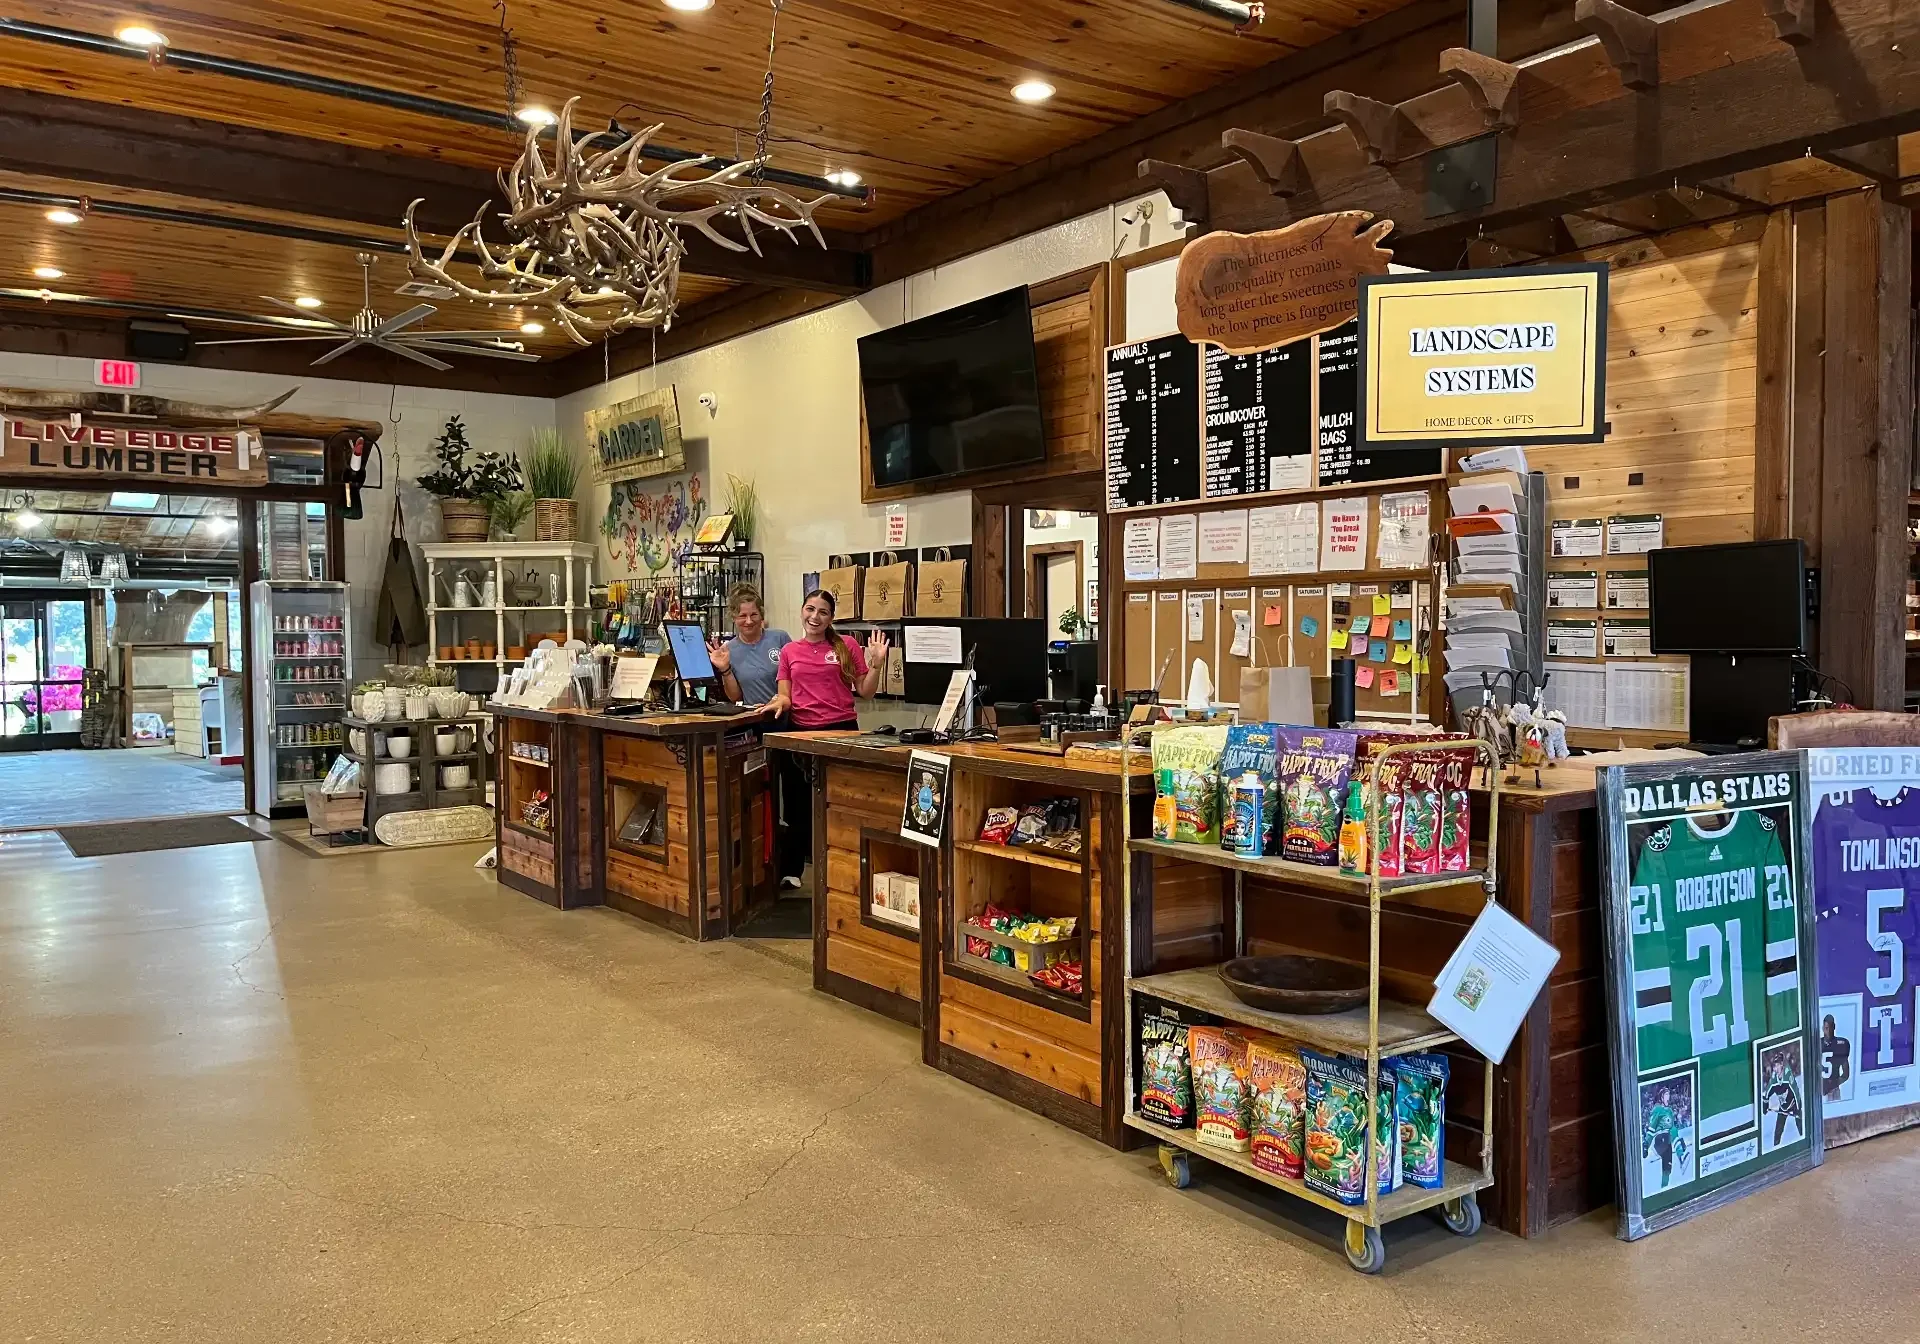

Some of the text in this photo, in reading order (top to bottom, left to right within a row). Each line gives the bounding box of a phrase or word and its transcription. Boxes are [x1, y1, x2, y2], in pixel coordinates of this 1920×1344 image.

[1220, 237, 1325, 273] The bitterness of
[1290, 257, 1342, 279] remains
[1199, 281, 1345, 320] long after the sweetness
[1207, 322, 1226, 337] the
[1229, 319, 1249, 333] low
[1252, 312, 1283, 333] price
[1286, 310, 1297, 322] is
[1411, 325, 1554, 353] LANDSCAPE
[1112, 343, 1148, 362] ANNUALS
[100, 360, 136, 386] EXIT
[1428, 366, 1534, 393] SYSTEMS
[1205, 405, 1266, 427] GROUNDCOVER
[1319, 411, 1353, 430] MULCH
[1424, 414, 1534, 427] HOME DECOR GIFTS
[11, 421, 233, 454] LIVE EDGE
[597, 414, 664, 466] GARDEN
[1320, 430, 1347, 447] BAGS
[30, 442, 218, 477] LUMBER
[1332, 515, 1341, 523] We
[1341, 515, 1356, 523] Have
[1337, 535, 1347, 543] You
[1347, 534, 1359, 543] Buy
[1189, 592, 1214, 600] WEDNESDAY
[1298, 588, 1323, 596] SATURDAY
[1360, 586, 1377, 594] NOTES
[1156, 742, 1194, 765] HAPPY
[1223, 749, 1258, 773] HAPPY
[1280, 753, 1313, 777] HAPPY
[1624, 773, 1791, 813] DALLAS STARS
[1675, 866, 1756, 912] ROBERTSON
[1764, 864, 1794, 911] 21
[1631, 883, 1665, 935] 21
[1866, 888, 1906, 998] 5
[1685, 918, 1750, 1057] 21
[1141, 1018, 1175, 1040] HAPPY
[1869, 1003, 1903, 1066] T
[1252, 1054, 1286, 1079] HAPPY
[1303, 1055, 1341, 1077] MARINE
[1311, 1178, 1362, 1199] FOR YOUR GARDEN
[1412, 1175, 1438, 1183] GARDEN
